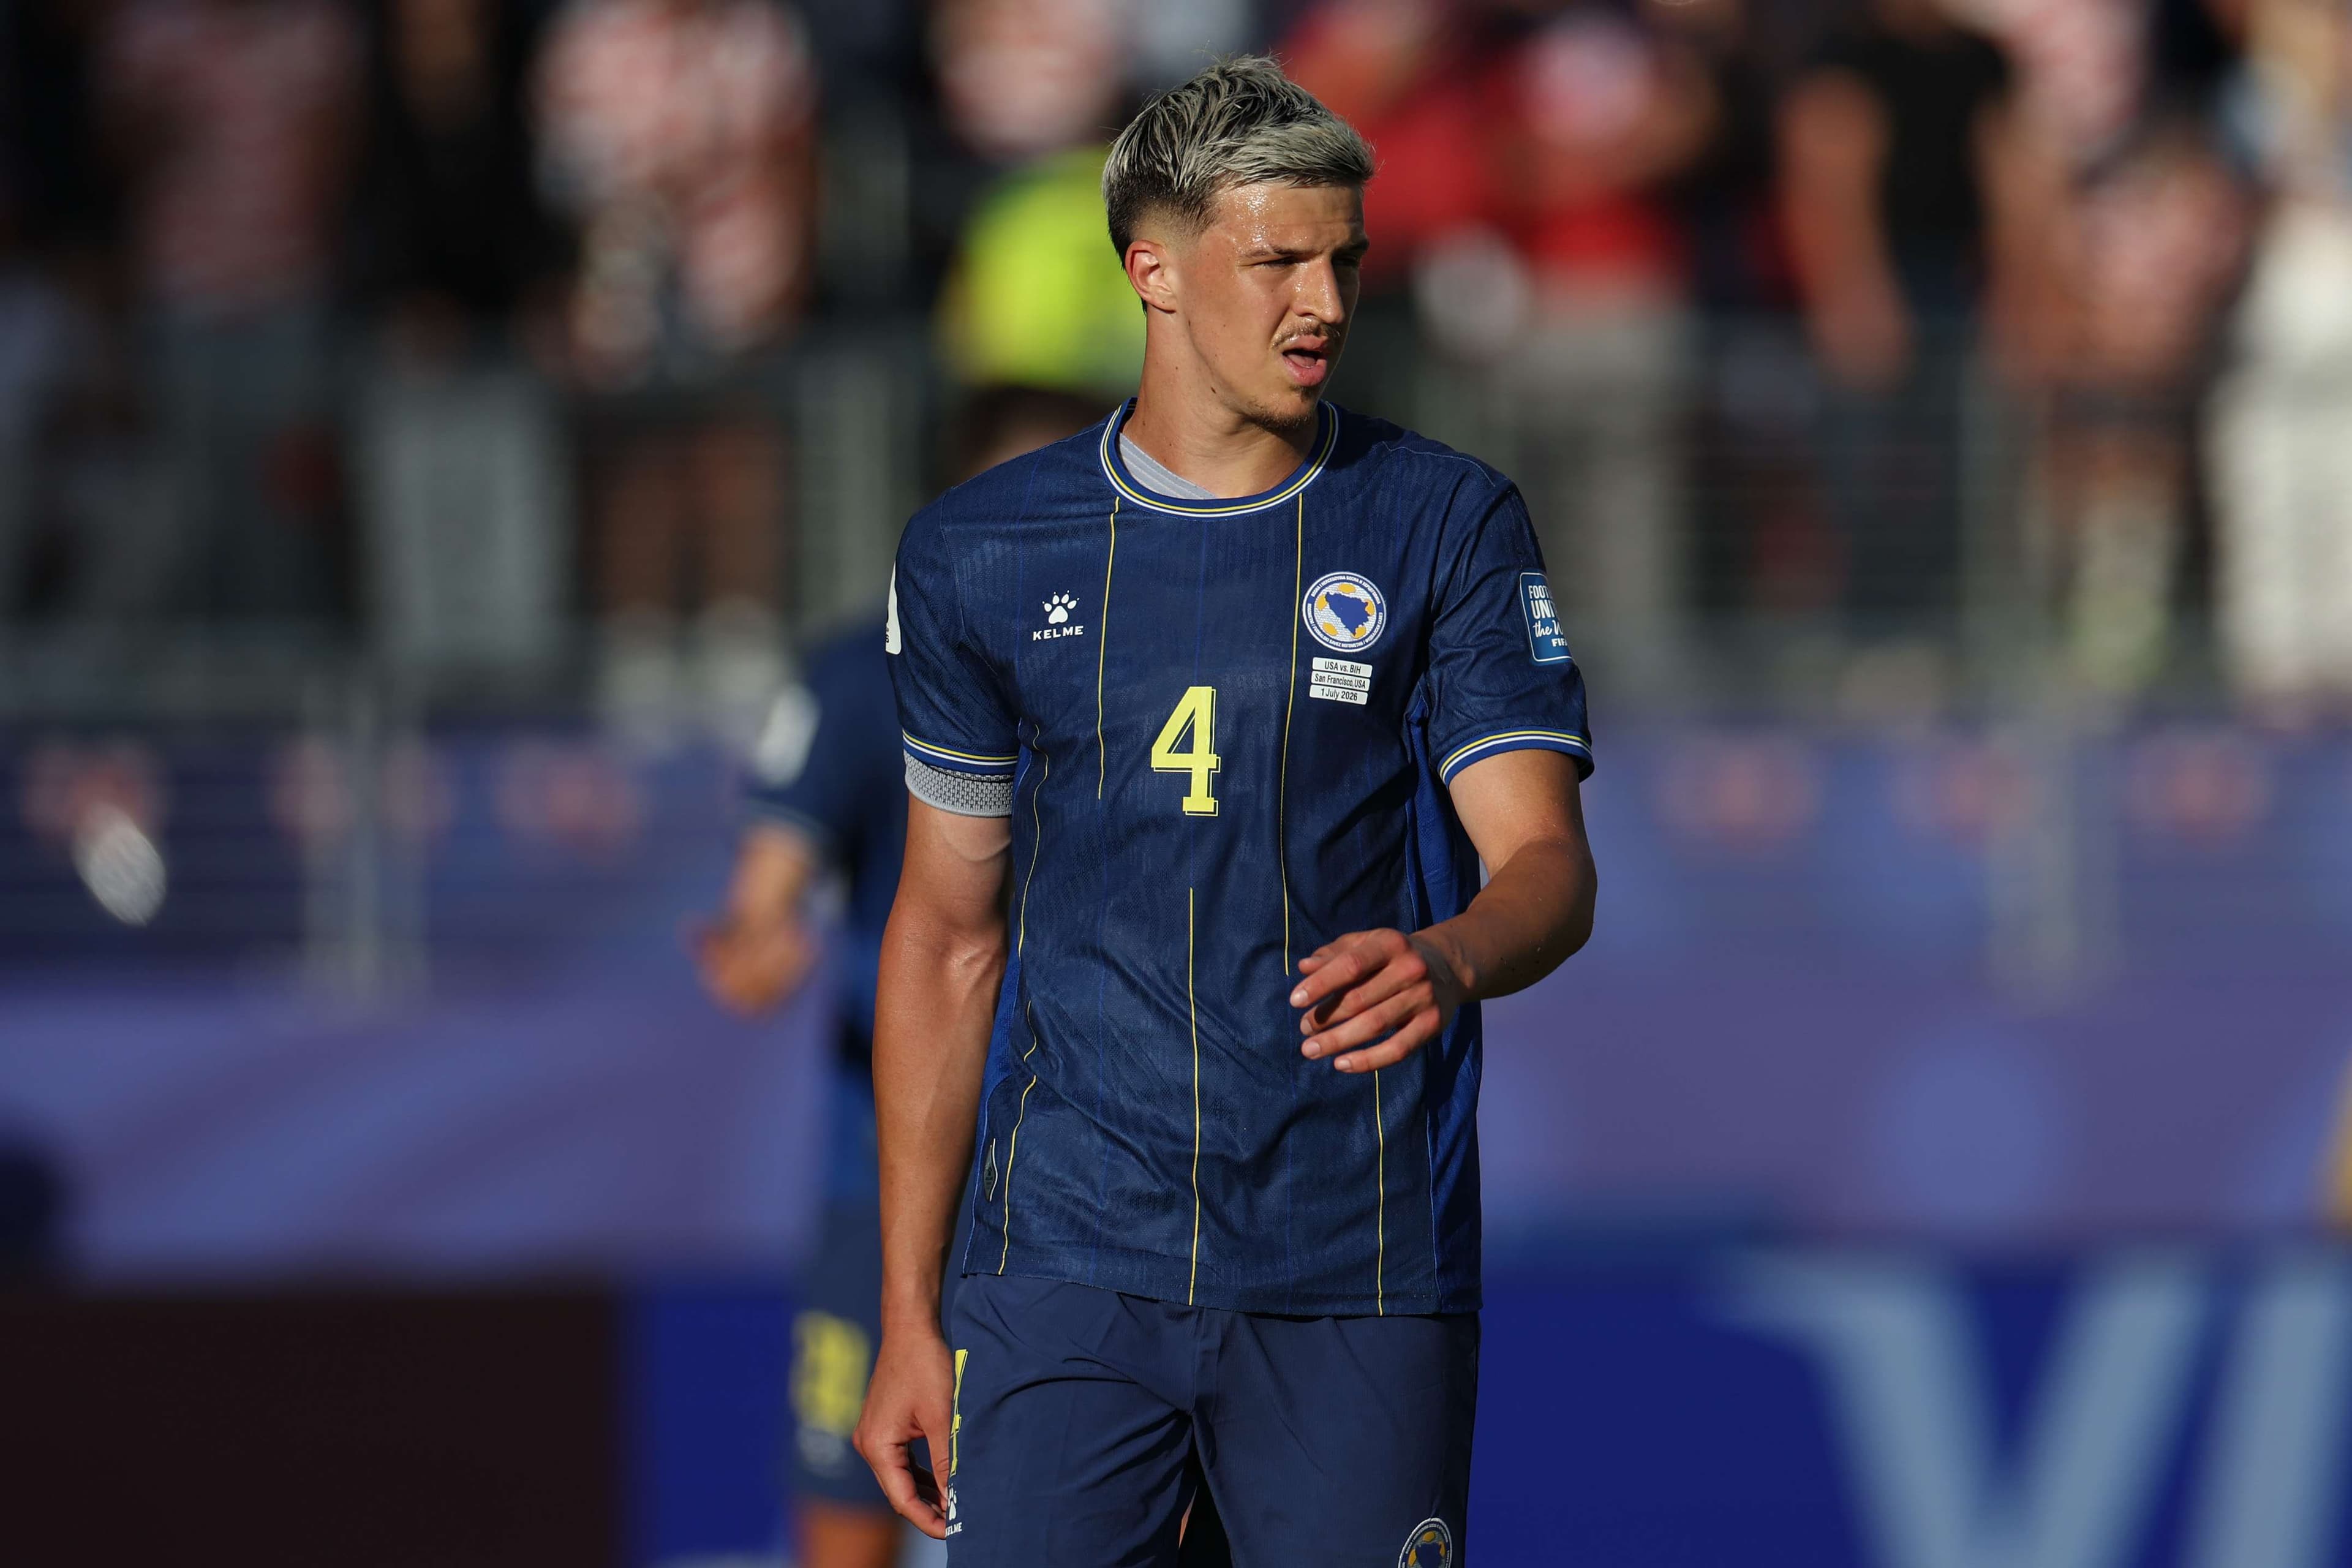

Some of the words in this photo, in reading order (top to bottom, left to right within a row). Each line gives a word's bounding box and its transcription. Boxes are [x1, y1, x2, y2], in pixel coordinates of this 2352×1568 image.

[1033, 625, 1084, 641] KELME
[1532, 620, 1553, 638] the
[1324, 661, 1338, 671] USA
[1350, 665, 1362, 674] BIH
[1314, 673, 1325, 682] San
[1354, 679, 1366, 689] USA
[1321, 688, 1324, 696] 1
[1325, 688, 1340, 701] July
[1341, 691, 1358, 701] 2026
[1151, 686, 1221, 816] 4
